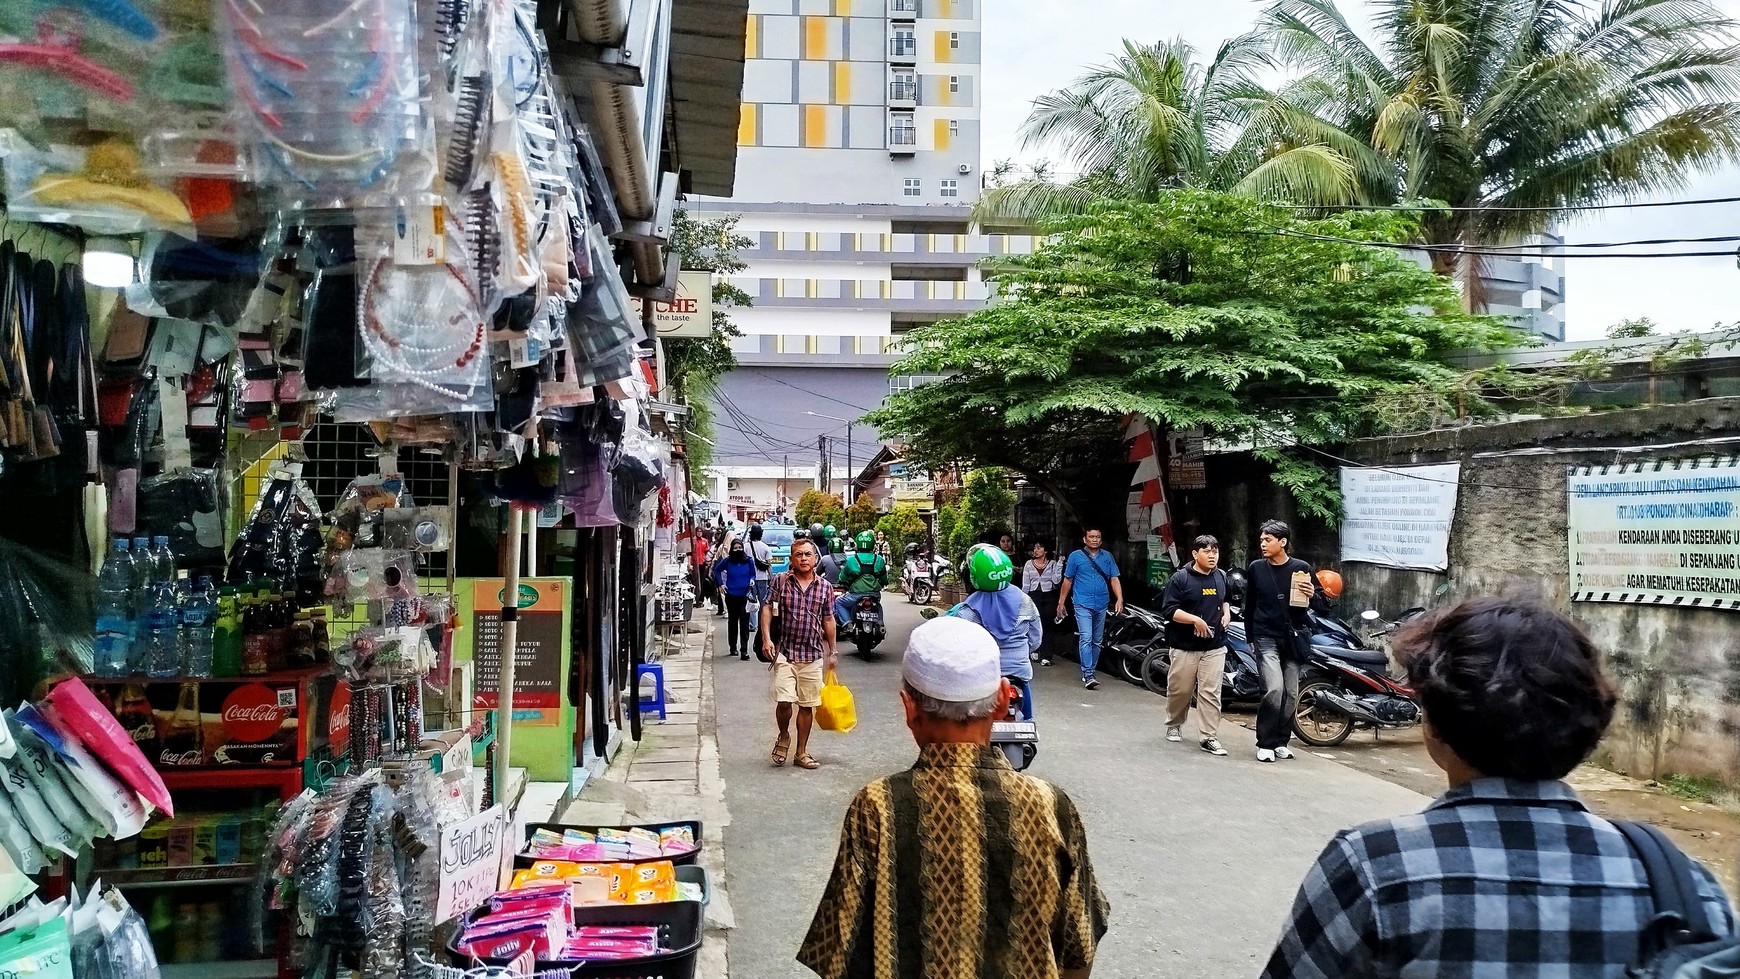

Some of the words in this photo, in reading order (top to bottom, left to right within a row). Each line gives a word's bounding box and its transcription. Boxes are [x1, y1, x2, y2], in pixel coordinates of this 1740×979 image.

[657, 313, 670, 321] the
[1618, 530, 1660, 545] KENDARAAN
[1661, 530, 1682, 545] ANDA
[1682, 529, 1732, 545] DISEBERANG
[1679, 553, 1688, 568] DI
[1689, 553, 1735, 570] SEPANJANG
[988, 565, 1013, 580] Grab
[1626, 574, 1646, 588] AGAR
[1646, 575, 1685, 590] MEMATUHI
[184, 611, 204, 622] AQUA
[225, 703, 279, 722] Coca-Cola
